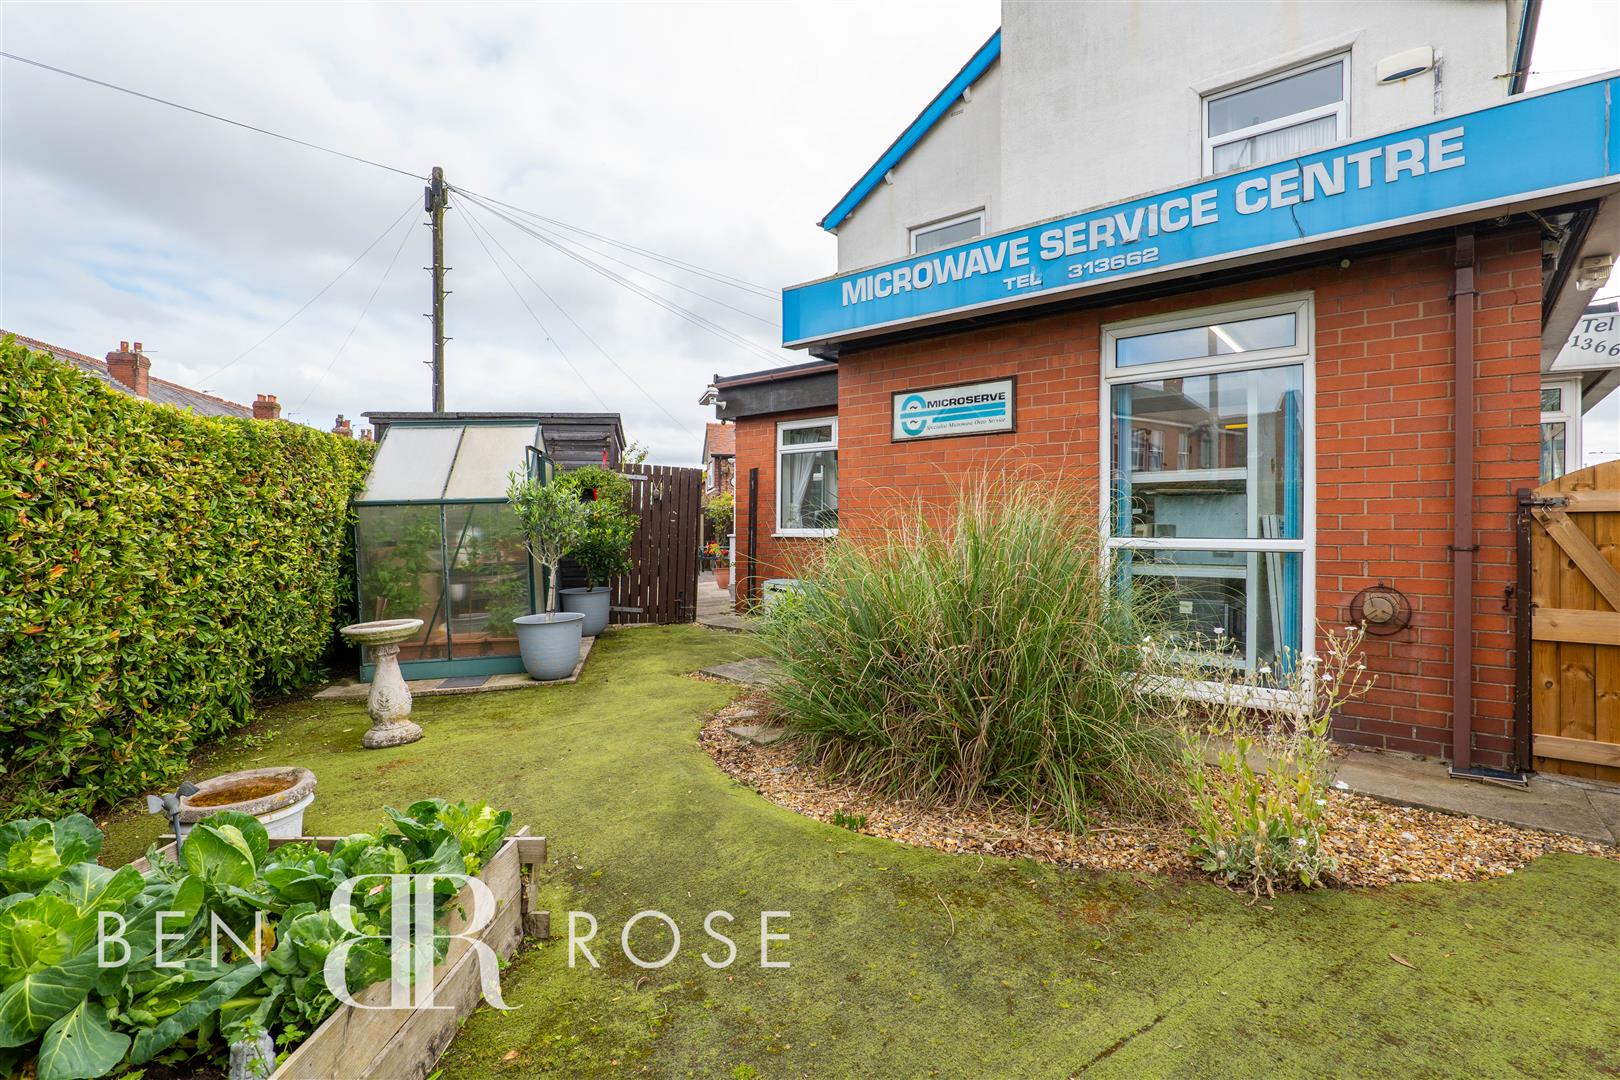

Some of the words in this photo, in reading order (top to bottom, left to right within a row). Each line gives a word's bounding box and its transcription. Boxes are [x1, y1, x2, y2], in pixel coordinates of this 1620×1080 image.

[841, 235, 1030, 307] MICROWAVE
[1039, 188, 1218, 261] SERVICE
[1235, 126, 1466, 216] CENTRE
[1002, 271, 1043, 290] TEL
[1067, 246, 1160, 279] 313662
[1582, 317, 1615, 333] Tel
[1567, 335, 1620, 356] 1366
[927, 392, 1006, 408] MICROSERVE
